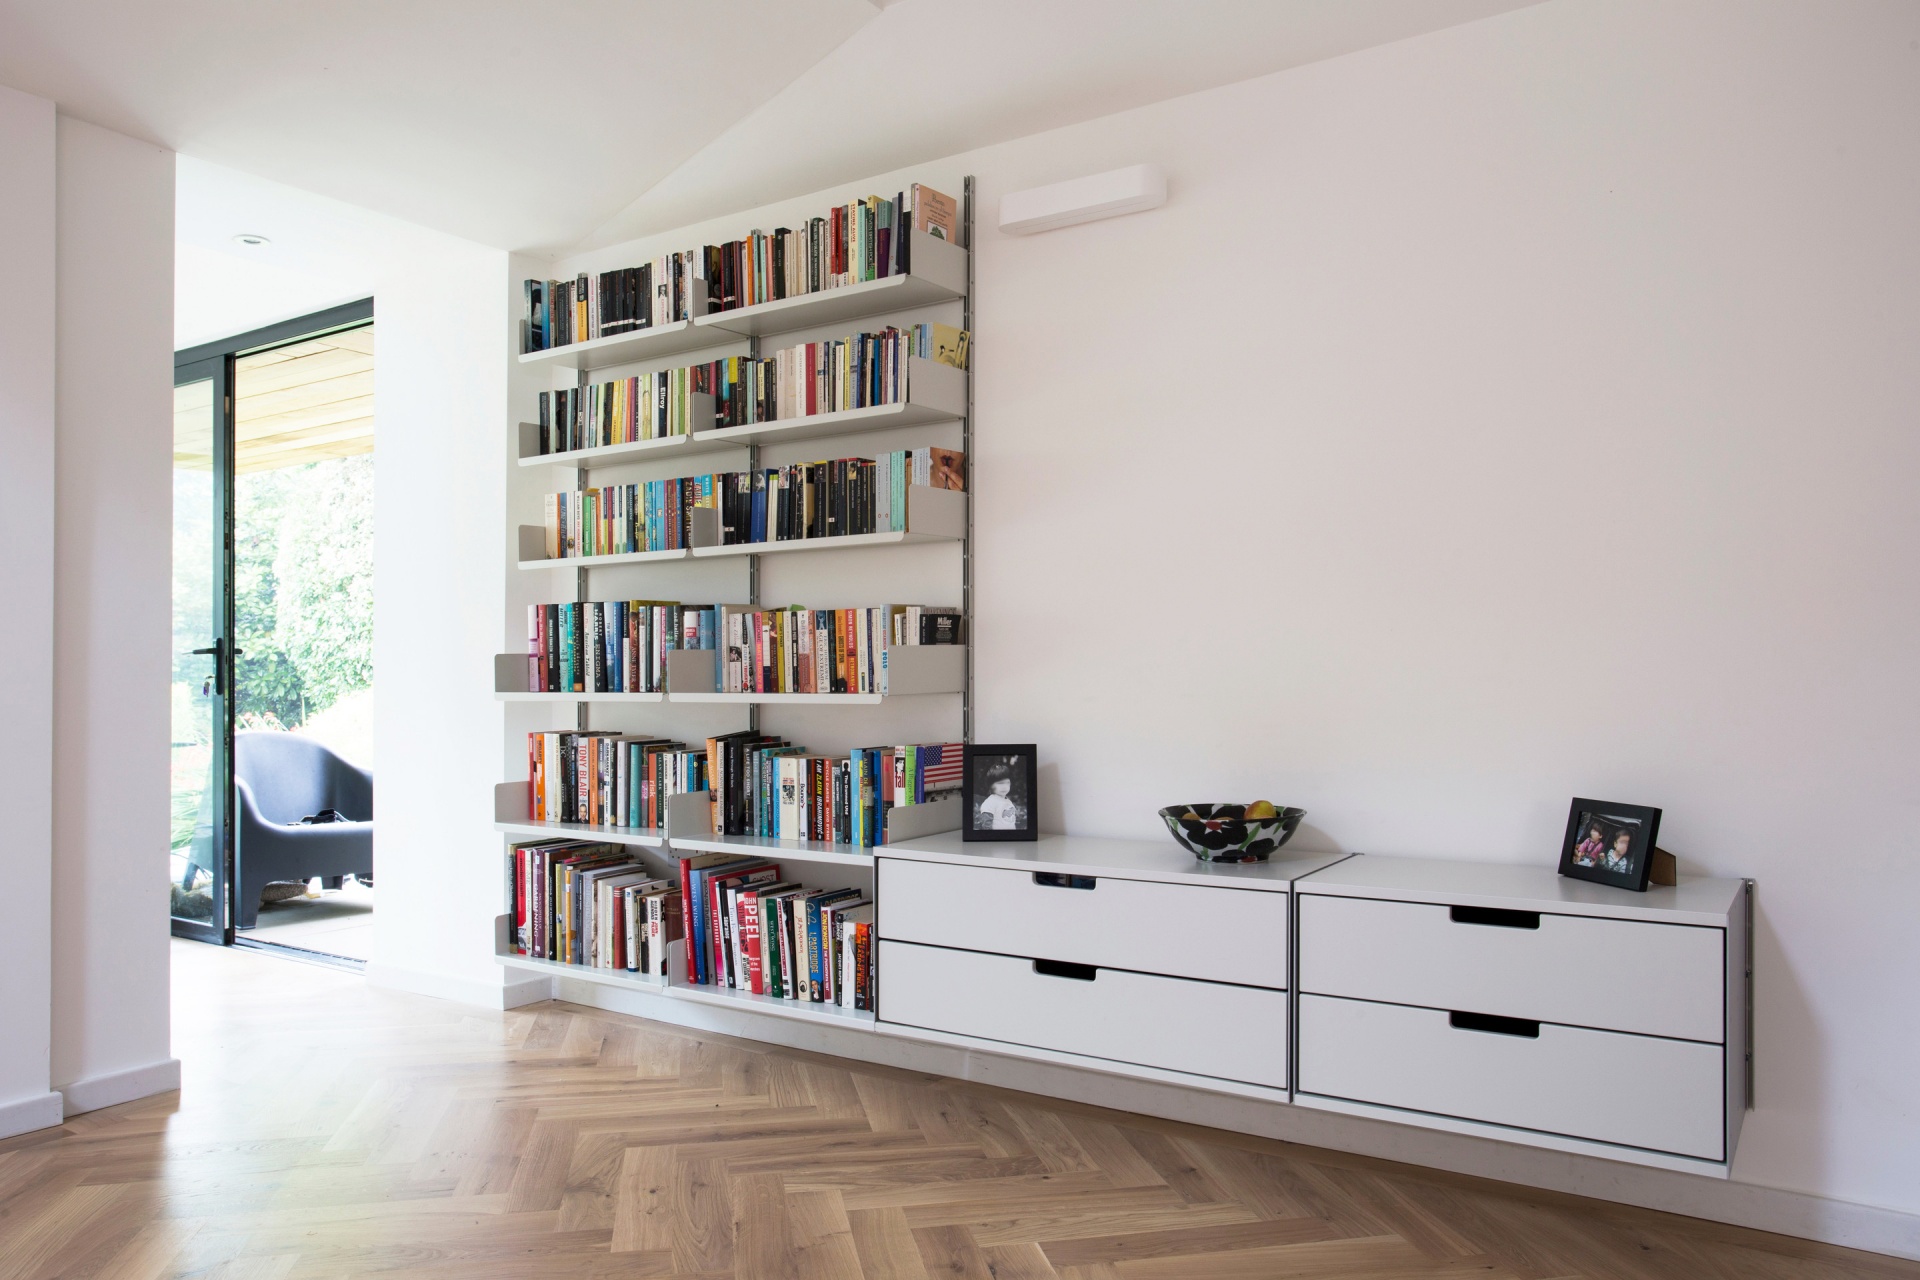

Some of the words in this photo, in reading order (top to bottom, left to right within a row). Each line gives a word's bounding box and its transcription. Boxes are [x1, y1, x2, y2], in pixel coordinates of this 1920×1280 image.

[686, 482, 694, 504] ZADIE
[936, 616, 952, 626] Miller
[579, 744, 588, 768] TONY
[579, 770, 588, 797] BLAIR
[895, 772, 905, 788] fall
[744, 904, 760, 943] PEEL
[810, 937, 818, 974] PARTRIDGE
